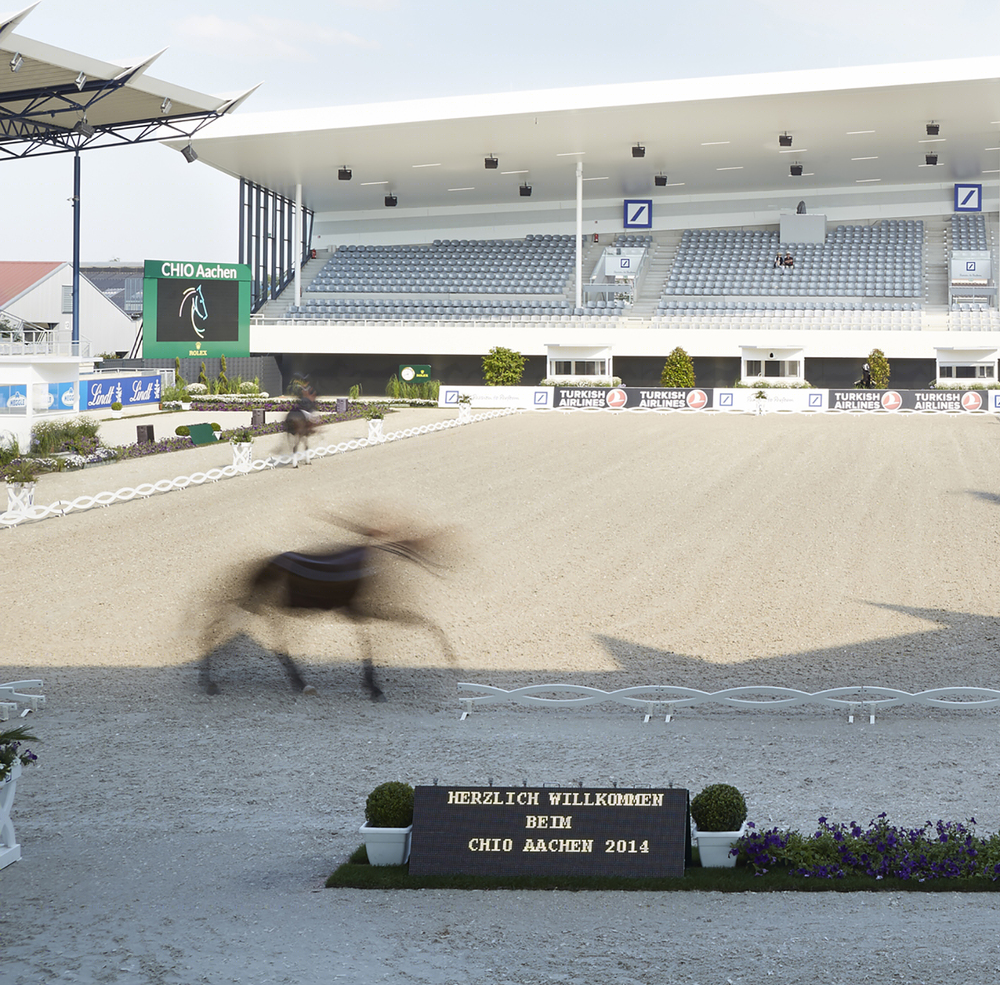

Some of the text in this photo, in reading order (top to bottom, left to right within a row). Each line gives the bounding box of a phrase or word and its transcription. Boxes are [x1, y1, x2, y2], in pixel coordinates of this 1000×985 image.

[161, 262, 237, 279] CHIO Aachen
[88, 383, 115, 407] Lindt
[129, 380, 153, 403] Lindt
[560, 390, 605, 398] TURKISH
[640, 391, 685, 399] TURKISH
[835, 393, 880, 401] TURKISH
[915, 393, 960, 401] TURKISH
[559, 398, 605, 407] AIRLINES
[639, 399, 685, 408] AIRLINES
[834, 401, 880, 410] AIRLINES
[914, 401, 960, 410] AIRLINES
[447, 791, 665, 807] HERZLICH WILLKOMMEN
[525, 816, 572, 829] BEIM
[468, 838, 649, 853] CHIO AACHEN 2014
